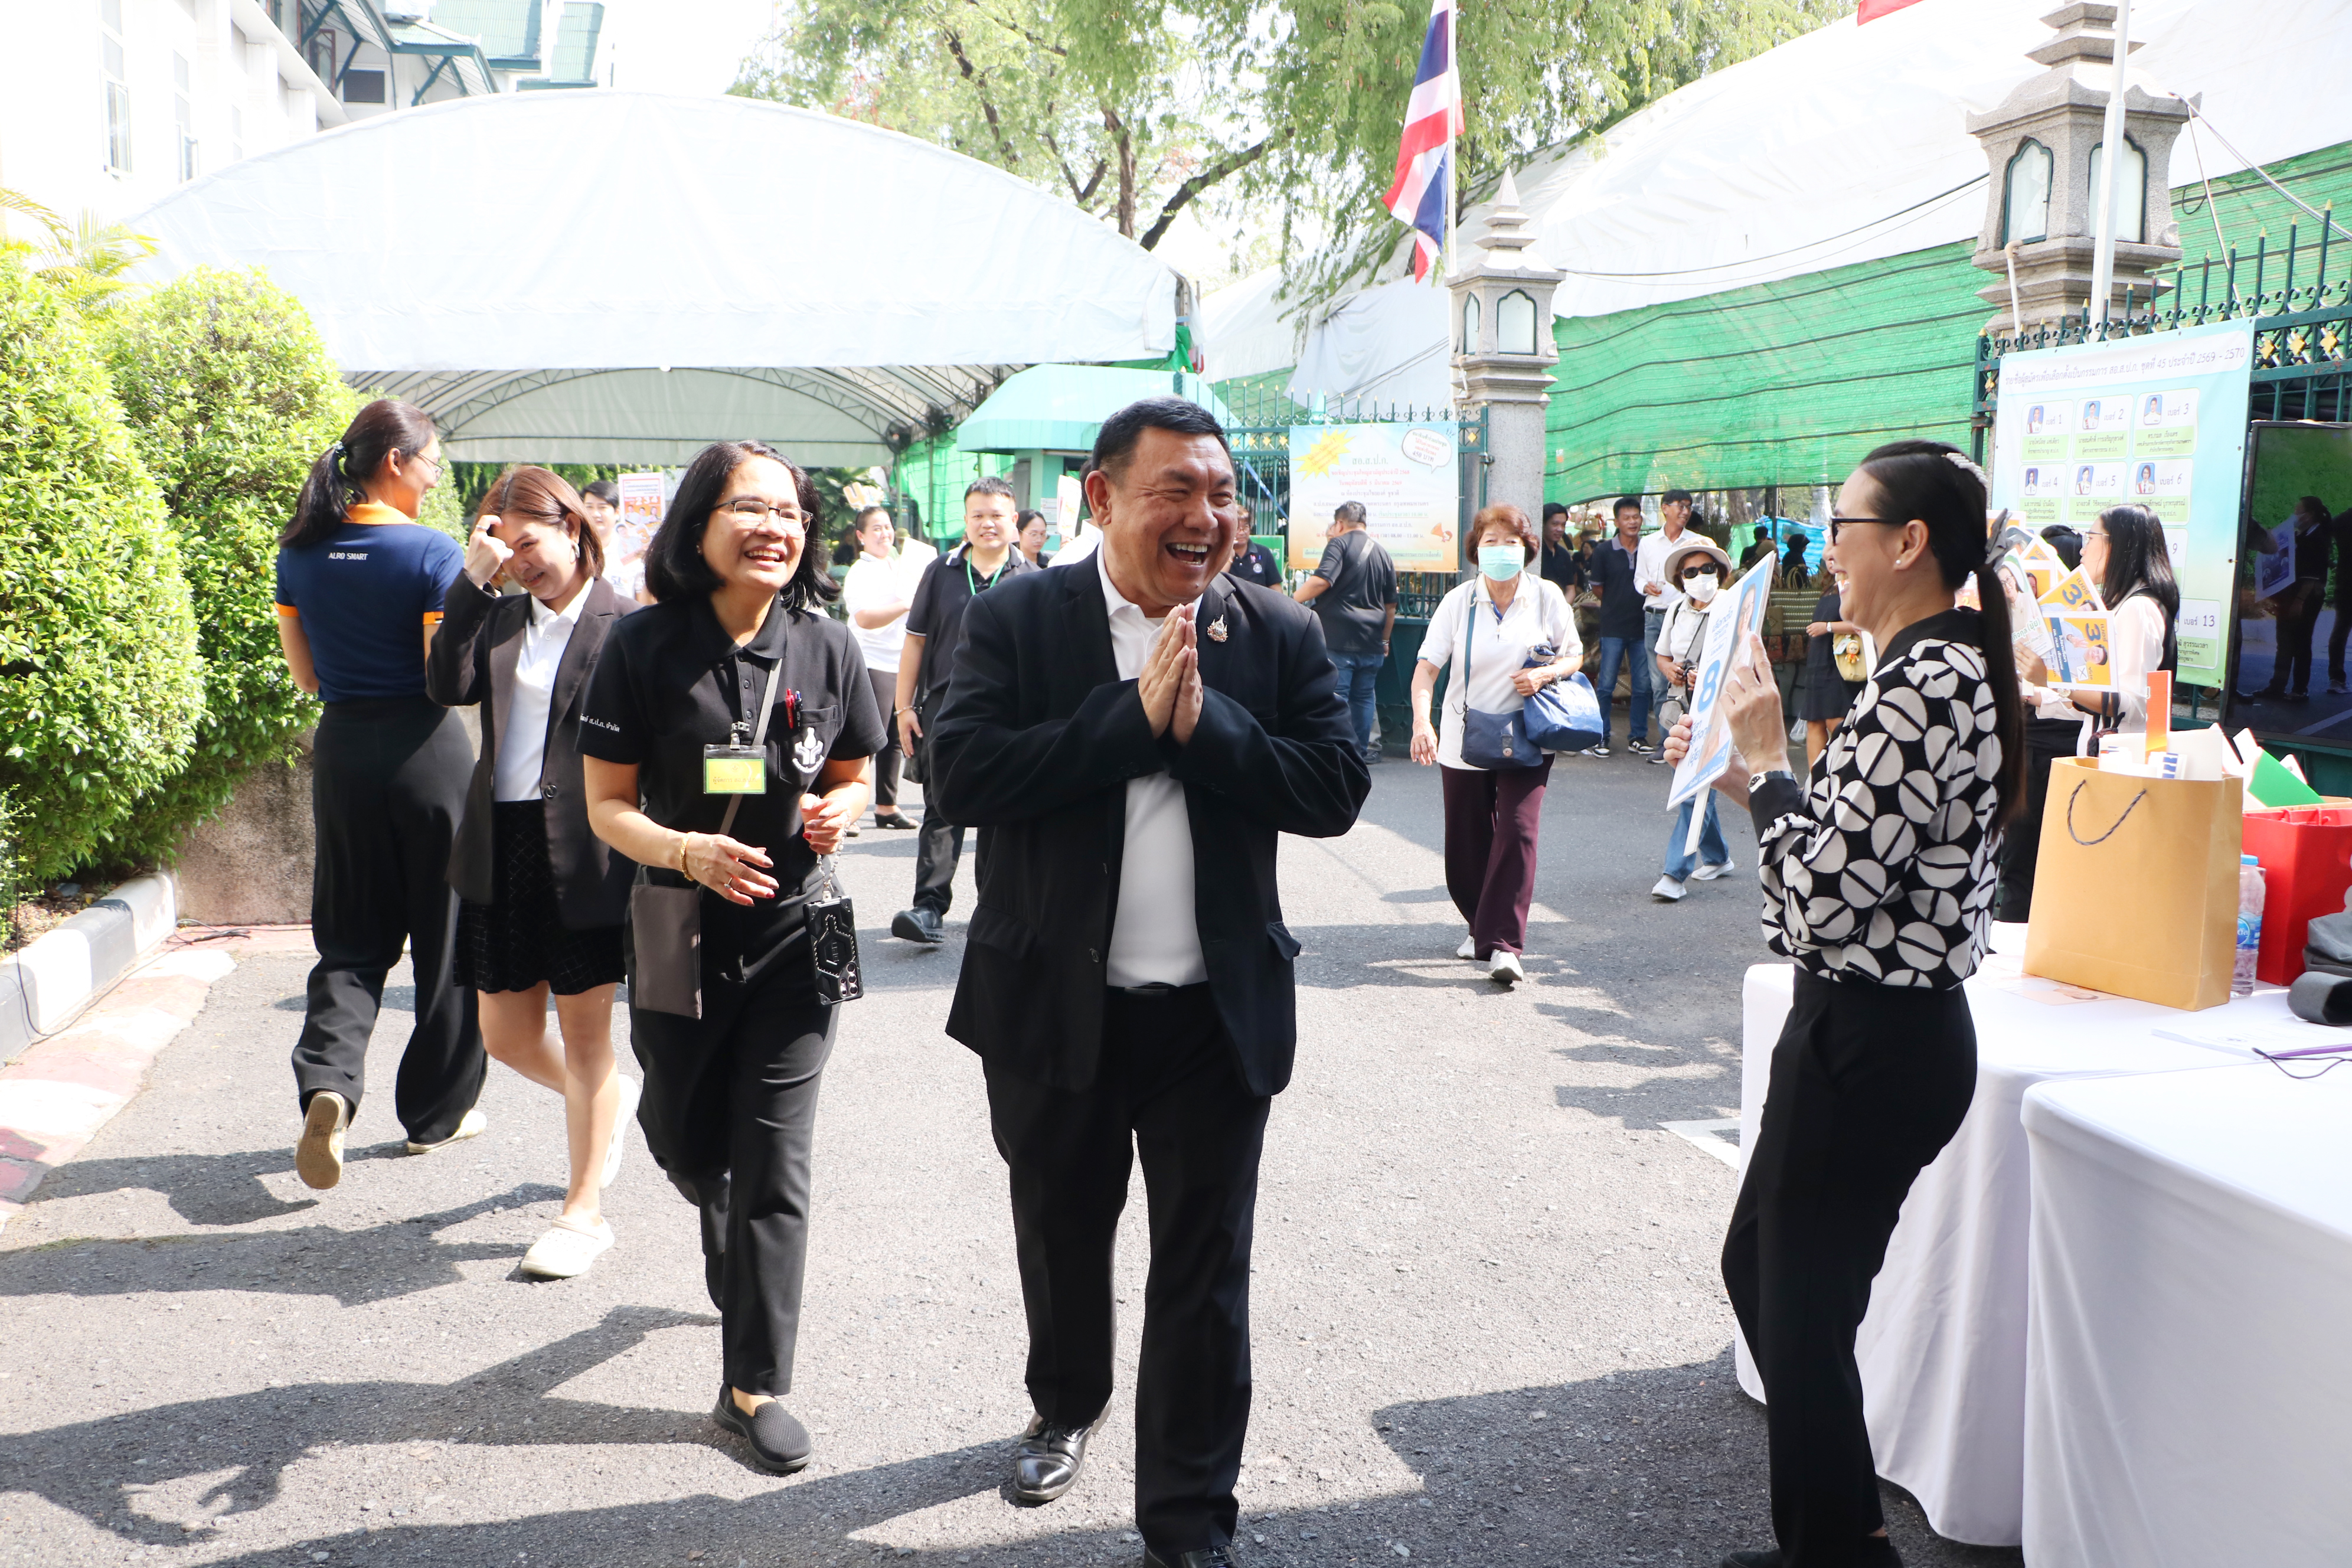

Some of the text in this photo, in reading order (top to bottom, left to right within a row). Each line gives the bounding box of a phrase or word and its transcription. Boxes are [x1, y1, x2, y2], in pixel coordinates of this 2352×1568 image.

[2141, 355, 2155, 374] ชุดที่
[2157, 358, 2165, 368] 45
[2168, 352, 2196, 367] ประจำปี
[2197, 352, 2215, 364] 2569
[2224, 347, 2245, 360] 2570
[2104, 409, 2124, 421] เบอร์ 2
[2167, 403, 2189, 416] เบอร์ 3
[2046, 414, 2062, 425] เบอร์ 1
[1352, 453, 1389, 465] สอ.ส.ป.ก.
[1423, 454, 1434, 462] บาท
[2041, 477, 2058, 487] เบอร์ 4
[2096, 475, 2116, 486] เบอร์ 5
[2160, 473, 2183, 485] เบอร์ 6
[2173, 543, 2178, 554] 9
[2062, 583, 2083, 605] 3
[2184, 615, 2215, 627] เบอร์ 13
[2085, 623, 2101, 641] 3
[1697, 659, 1720, 713] 8
[606, 721, 620, 732] จำกัด
